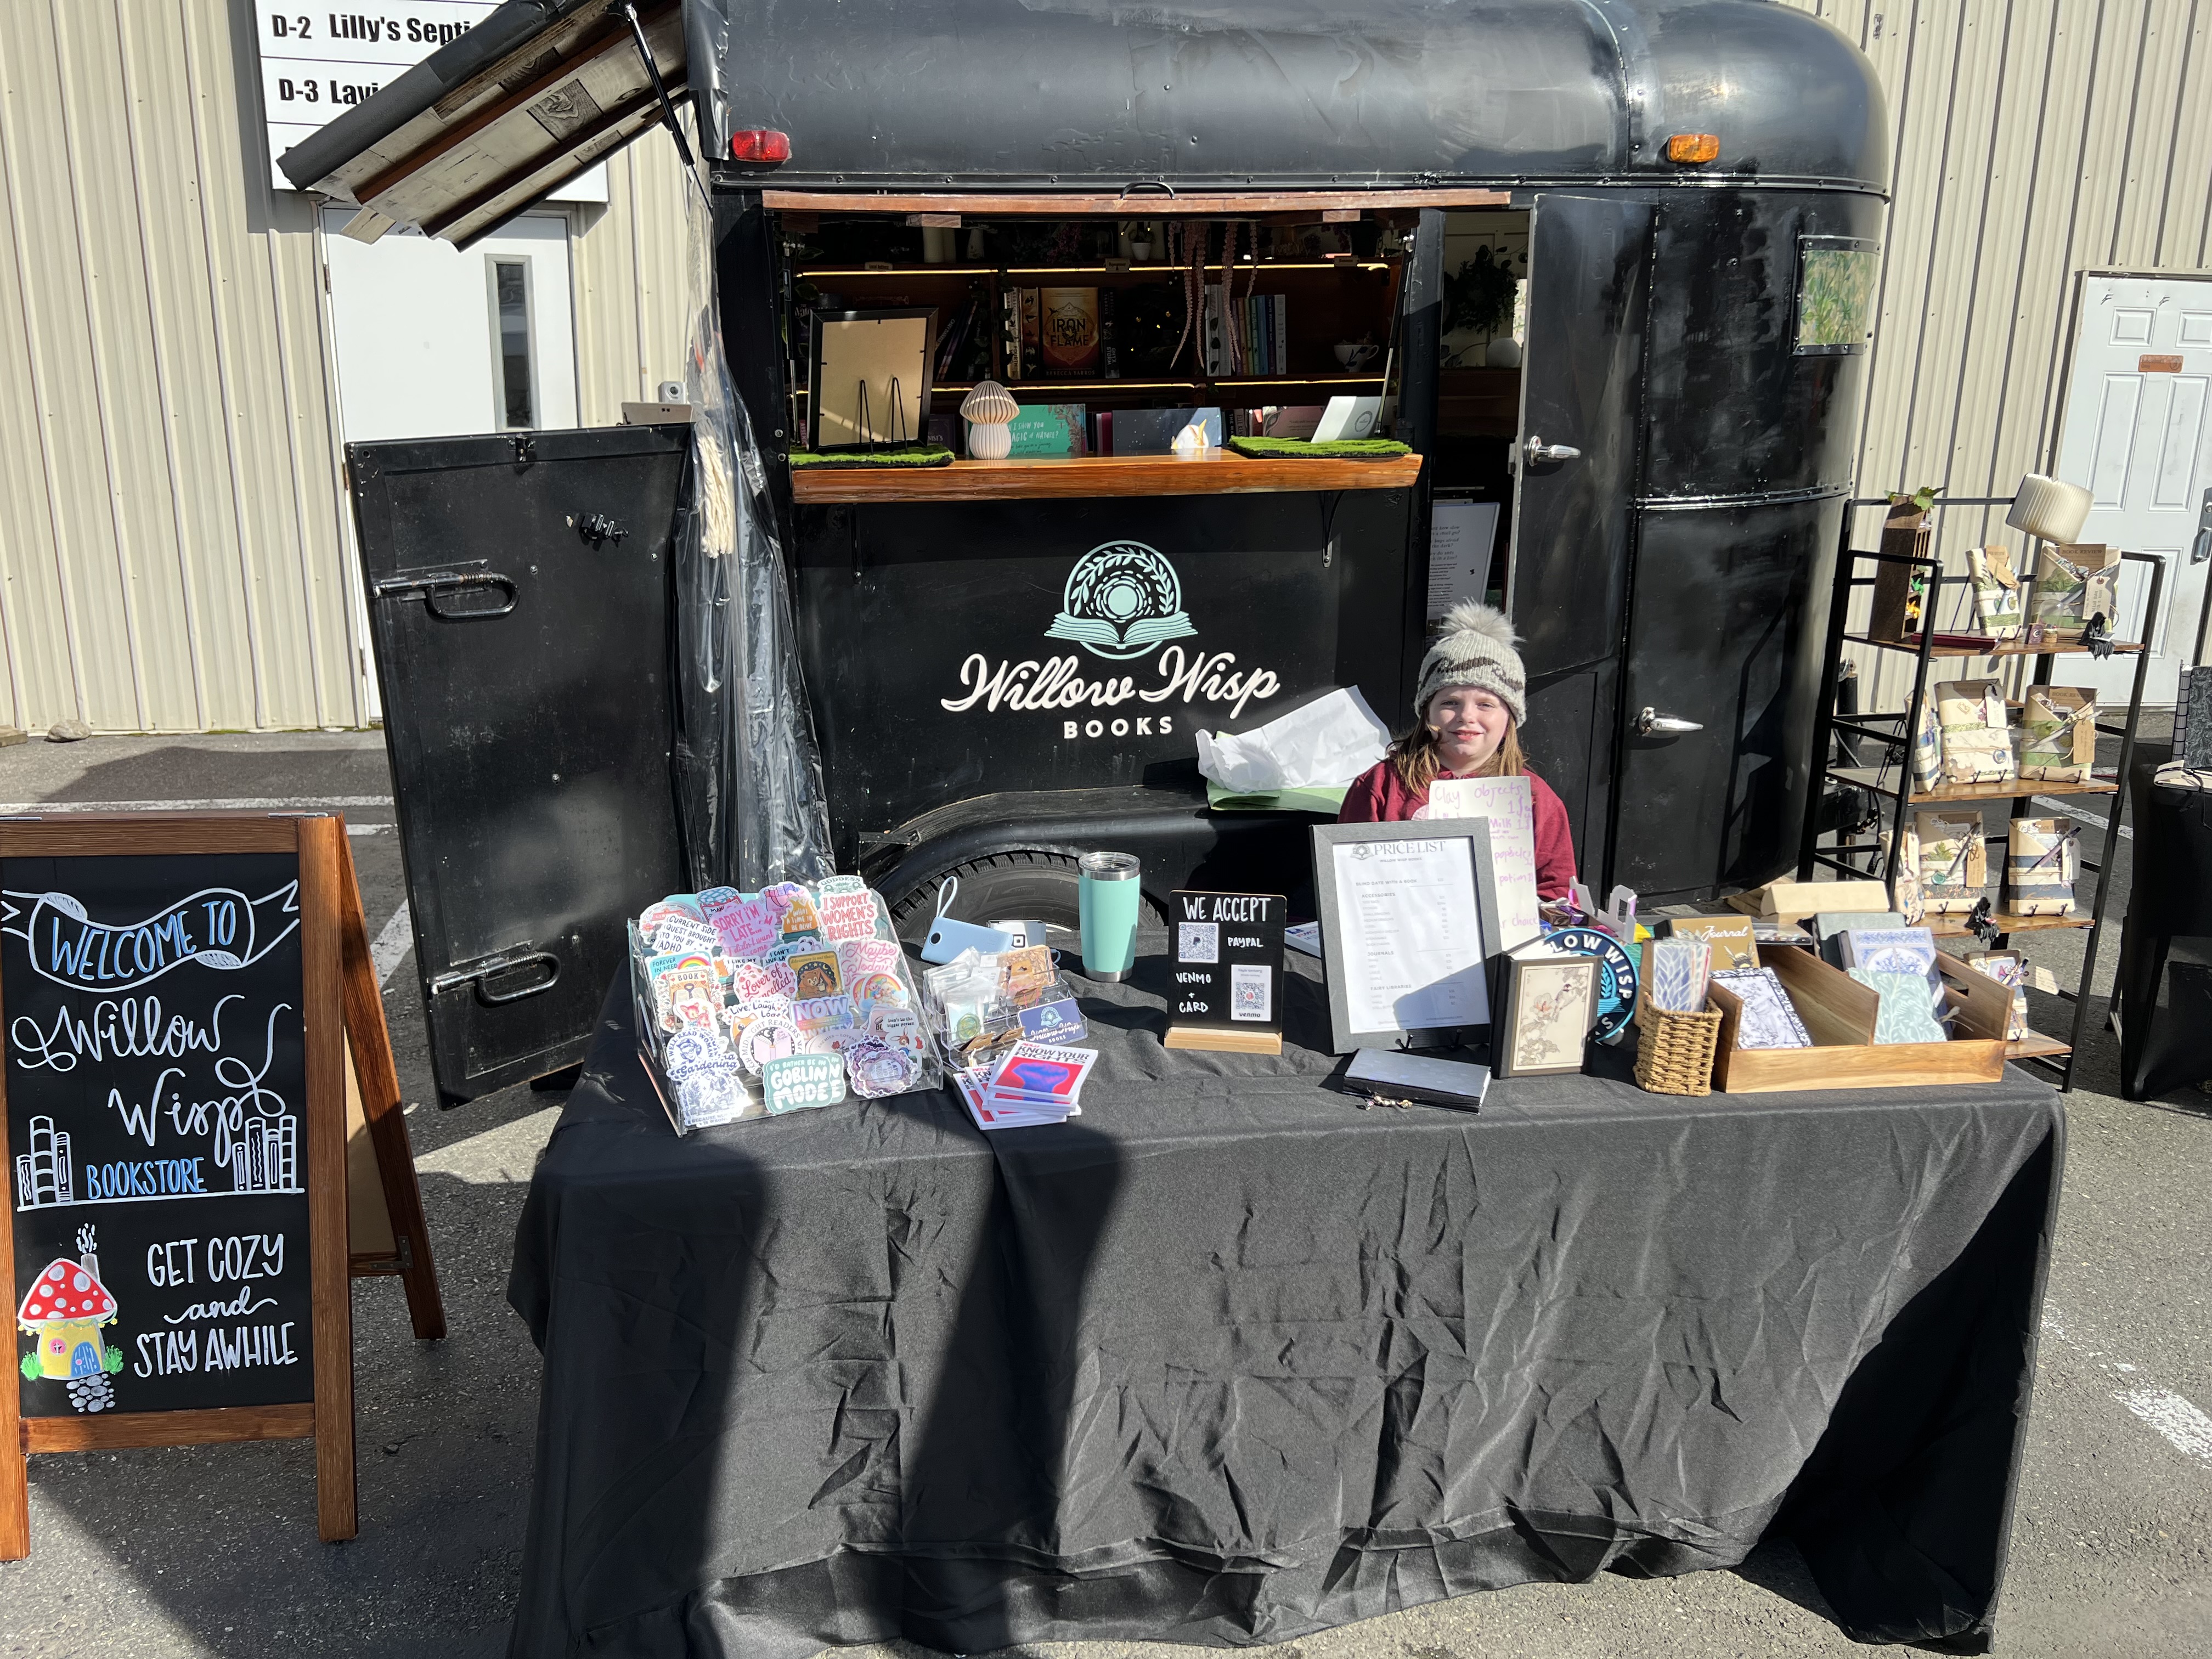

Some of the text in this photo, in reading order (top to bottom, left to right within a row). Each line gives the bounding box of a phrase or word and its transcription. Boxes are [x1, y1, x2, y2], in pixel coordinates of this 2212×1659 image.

[272, 14, 312, 40] D-2
[329, 14, 401, 42] Lilly's
[279, 78, 319, 103] D-3
[1052, 318, 1086, 332] IRON
[1050, 332, 1090, 347] FLAME
[1036, 431, 1059, 439] NATURE?
[940, 645, 1281, 719] Willow Wisp
[1063, 716, 1173, 739] BOOKS
[1435, 786, 1460, 810] Clay
[1374, 840, 1446, 855] PRICE LIST
[821, 877, 861, 885] GODDESS
[823, 893, 868, 911] I SUPPORT
[1183, 896, 1271, 922] WE ACCEPT
[713, 910, 744, 933] SORRY
[793, 908, 808, 917] WHAT
[820, 904, 874, 926] WOMEN'S
[669, 915, 701, 930] CURRENT
[827, 919, 873, 941] RIGHTS
[52, 900, 236, 980] WELCOME TO
[666, 924, 716, 944] QUEST BROUGHT
[673, 934, 685, 943] YOU
[756, 929, 774, 944] want
[1227, 936, 1264, 948] PAYPAL
[1701, 925, 1749, 942] Journal
[659, 940, 682, 952] ADHD
[750, 944, 768, 955] come
[846, 941, 897, 960] Maybe
[652, 957, 676, 968] FOREVER
[678, 973, 699, 981] BOOK
[742, 962, 782, 998] Lover of
[1176, 972, 1211, 984] VENMO
[1604, 945, 1633, 1000] WISP
[793, 997, 849, 1021] NOW
[1179, 1001, 1209, 1013] CARD
[12, 995, 244, 1072] Willow
[768, 1019, 801, 1039] READERS
[668, 1038, 678, 1057] WELL
[677, 1030, 697, 1039] READ
[699, 1032, 714, 1058] WOMAN
[1048, 1035, 1066, 1043] BOOKS
[1015, 1051, 1086, 1064] RIGHTS
[1018, 1046, 1090, 1060] KNOW YOUR
[676, 1060, 737, 1077] Gardening
[782, 1059, 805, 1069] RATHER
[771, 1065, 827, 1090] GOBLIN
[772, 1082, 829, 1110] MODE
[87, 1156, 207, 1199] BOOKSTORE
[147, 1233, 284, 1287] GET COZY
[163, 1285, 278, 1324] and
[134, 1322, 298, 1378] STAY AWHILE
